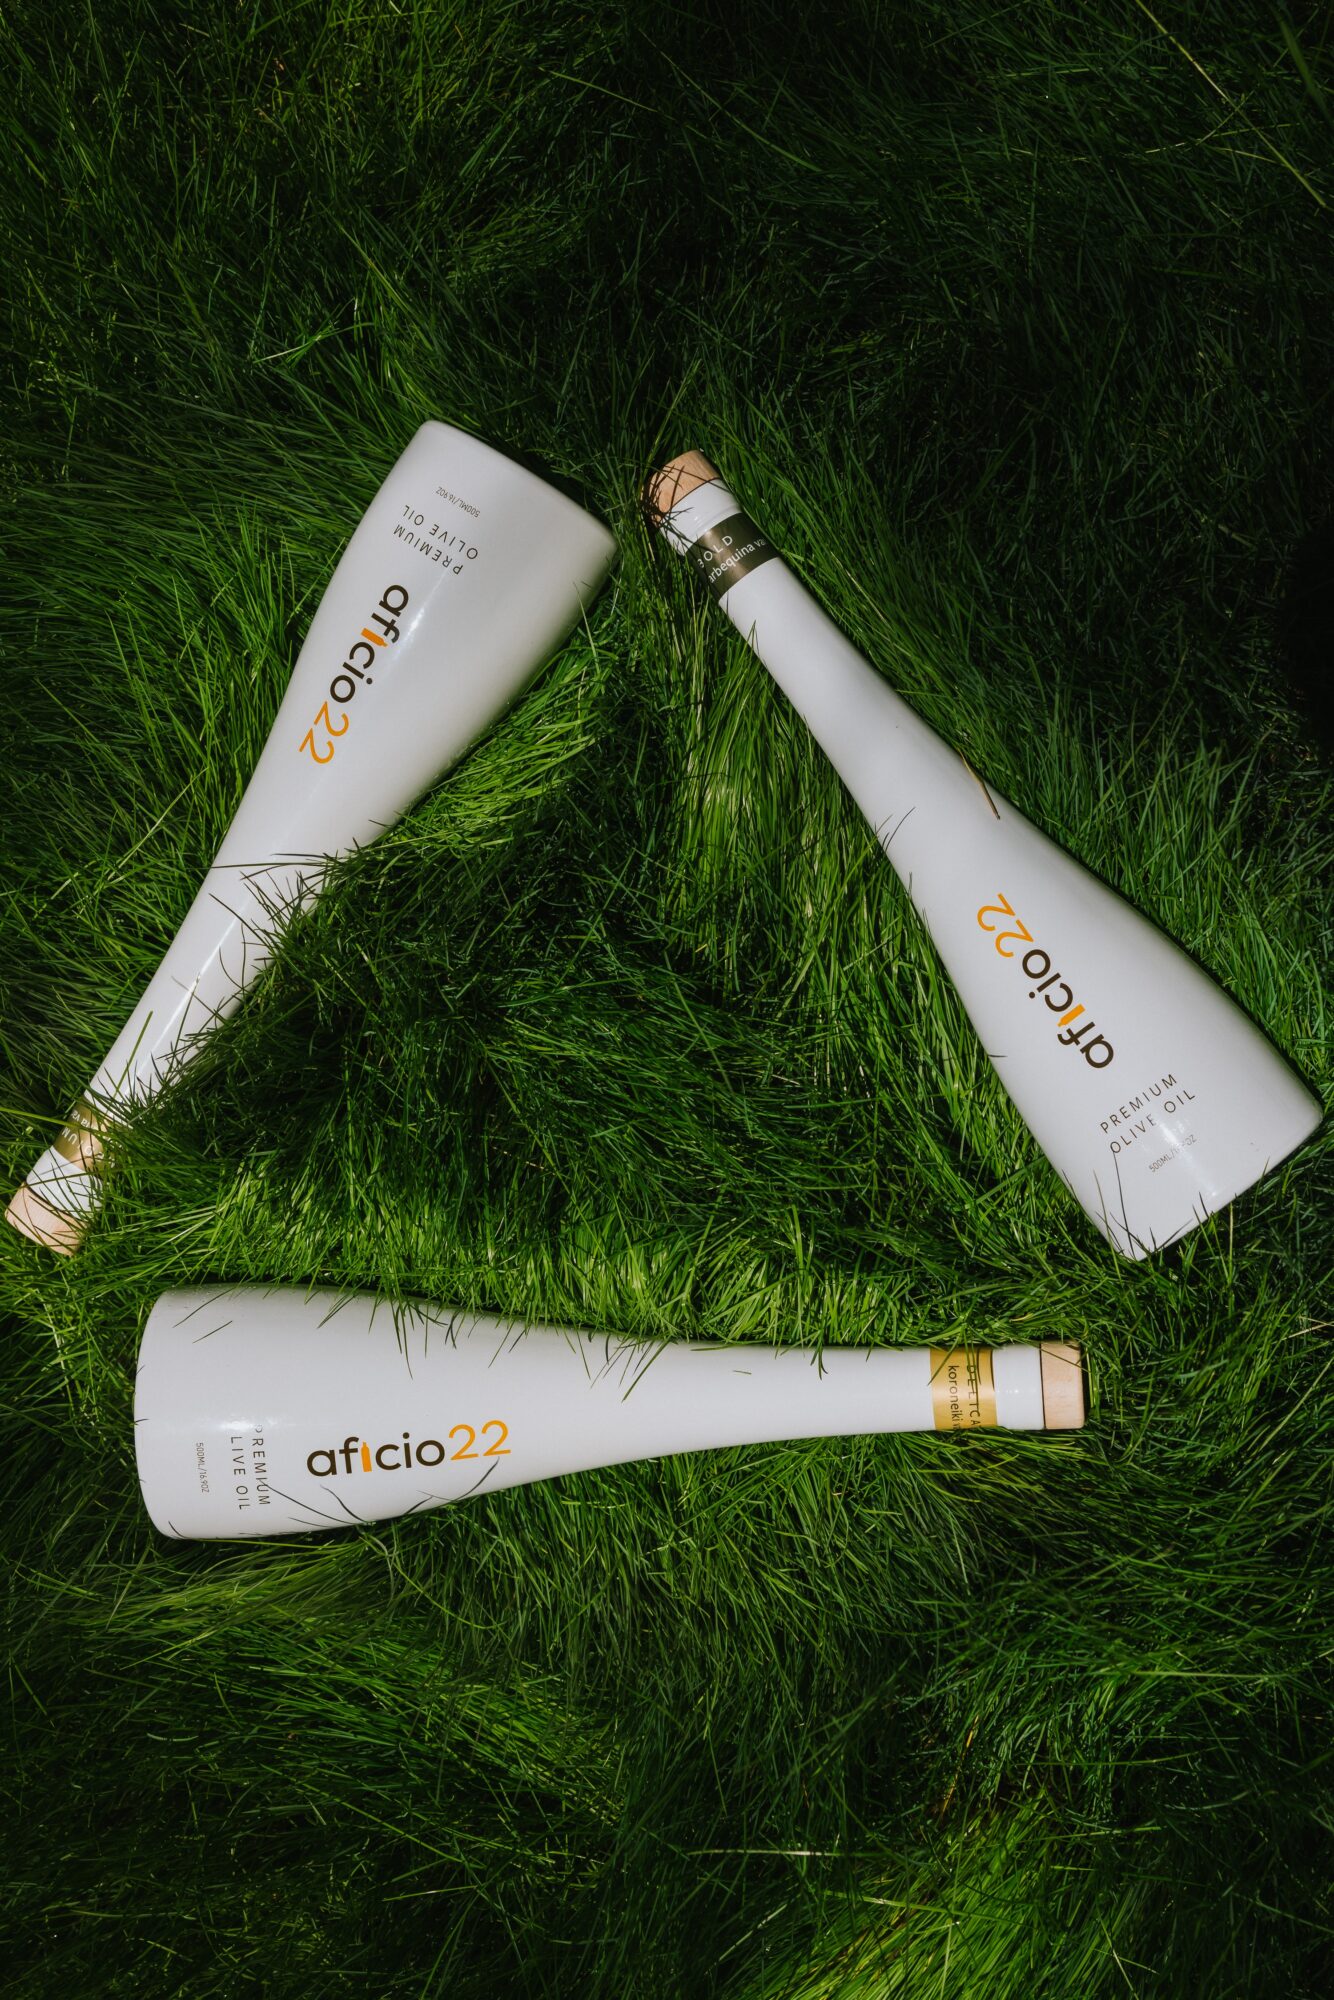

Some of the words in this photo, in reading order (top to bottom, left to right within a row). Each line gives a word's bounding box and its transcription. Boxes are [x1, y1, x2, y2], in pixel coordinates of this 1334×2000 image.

[402, 504, 424, 526] OIL
[429, 524, 479, 560] OLIVE
[393, 524, 463, 575] PREMIUM
[708, 543, 755, 584] arbequina
[299, 584, 409, 764] aficio22
[977, 893, 1114, 1069] aficio22
[1100, 1073, 1177, 1134] PREMIUM
[1110, 1114, 1157, 1154] OLIVE
[1163, 1089, 1195, 1114] OIL
[947, 1365, 963, 1421] koroneiki
[230, 1436, 247, 1476] LIVE
[252, 1423, 271, 1506] PREMIUM
[306, 1419, 511, 1477] aficio22
[235, 1485, 251, 1510] OIL
